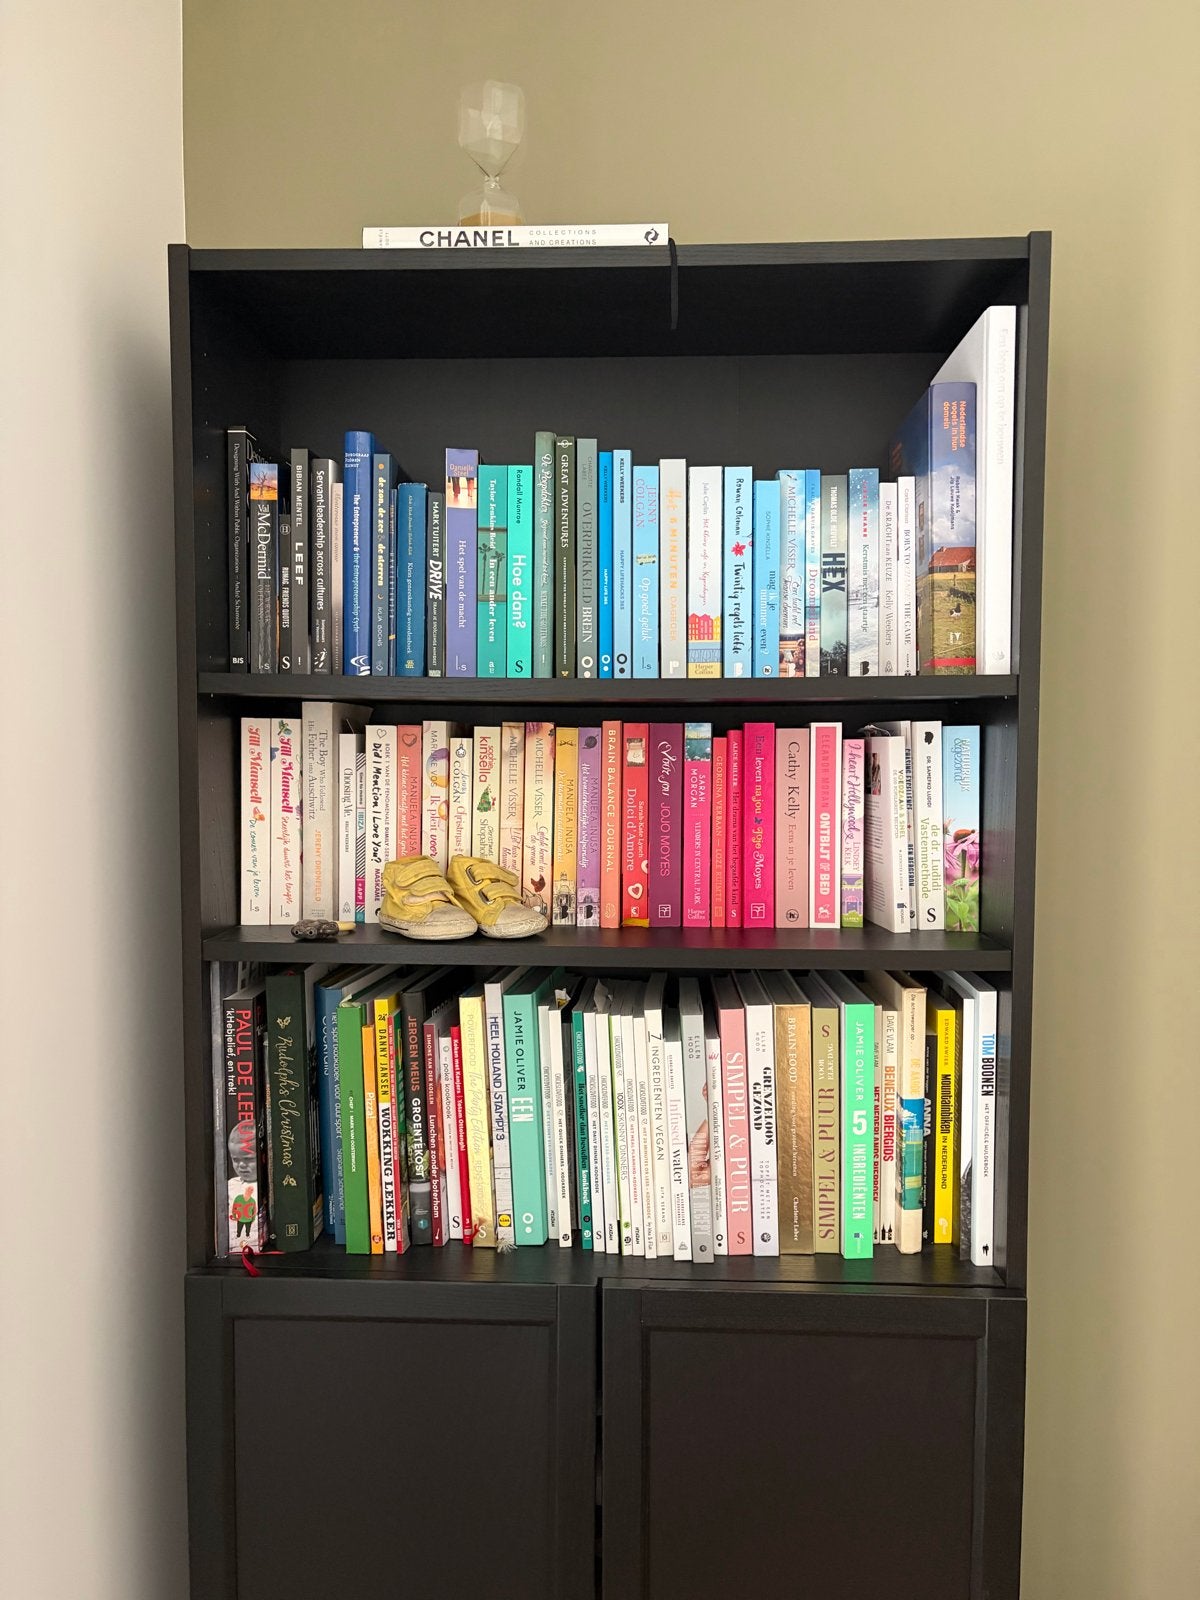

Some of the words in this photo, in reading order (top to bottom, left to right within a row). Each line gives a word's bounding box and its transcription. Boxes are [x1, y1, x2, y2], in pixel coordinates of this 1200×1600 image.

[420, 231, 520, 247] CHANEL
[315, 470, 325, 548] Servant-leadership
[560, 488, 568, 548] ADVENTURES
[636, 478, 644, 528] COLGAN
[648, 486, 656, 523] JENNY
[257, 512, 270, 579] McDermid
[582, 502, 592, 603] OVERPRIKKELD
[786, 538, 796, 572] VISSER
[429, 560, 442, 600] DRIVE
[457, 555, 466, 572] spel
[512, 554, 526, 586] Hoe
[729, 562, 744, 600] Twintig
[822, 552, 845, 592] HEX
[316, 578, 325, 610] cultures
[459, 592, 466, 602] de
[640, 578, 650, 592] Op
[884, 590, 894, 610] Kelly
[512, 591, 526, 628] dan?
[640, 594, 650, 614] goed
[731, 602, 744, 628] regels
[582, 606, 592, 642] BREIN
[642, 616, 650, 642] geluk
[732, 632, 744, 654] liefde
[248, 725, 260, 746] Jill
[280, 736, 292, 756] Jill
[308, 733, 317, 760] Father
[373, 743, 382, 759] Did
[755, 735, 764, 755] Een
[249, 748, 262, 803] Mansell
[318, 751, 328, 767] Boy
[479, 736, 492, 782] kinsella
[508, 736, 517, 784] MICHELLE
[535, 737, 544, 785] MICHELLE
[755, 757, 764, 782] leven
[785, 742, 800, 780] Cathy
[951, 738, 963, 783] &gezond
[960, 738, 970, 792] NATUURLIJK
[281, 759, 293, 813] Mansell
[308, 775, 317, 820] Auschwitz
[372, 766, 382, 808] Mention
[453, 760, 461, 803] COLGAN
[607, 767, 615, 817] BALANCE
[755, 785, 761, 796] na
[506, 788, 517, 819] VISSER
[533, 788, 544, 819] VISSER
[627, 788, 637, 819] Dolci
[660, 802, 670, 832] JOJO
[752, 796, 763, 814] jou
[785, 786, 800, 819] Kelly
[373, 816, 382, 838] Love
[752, 827, 763, 849] Jojo
[931, 825, 940, 837] de
[372, 842, 382, 863] You?
[606, 822, 614, 872] JOURNAL
[627, 822, 637, 871] d'Amore
[660, 836, 670, 876] MOYES
[920, 818, 930, 899] Vastenmethode
[931, 840, 940, 854] dr.
[754, 851, 764, 889] Moyes
[932, 859, 940, 891] Ludidi
[236, 1009, 252, 1055] PAUL
[408, 1016, 419, 1058] JEROEN
[490, 1017, 500, 1040] HEEL
[514, 1011, 524, 1045] JAMIE
[788, 1017, 797, 1049] BRAIN
[855, 1021, 864, 1056] JAMIE
[886, 1016, 895, 1033] DAVE
[379, 1029, 387, 1058] DANNY
[886, 1035, 895, 1054] VLAM
[982, 1034, 994, 1055] TOM
[237, 1061, 252, 1085] DE
[380, 1062, 389, 1095] JANSEN
[410, 1061, 420, 1091] MEUS
[492, 1043, 502, 1088] HOLLAND
[516, 1049, 526, 1091] OLIVER
[789, 1053, 798, 1082] FOOD
[856, 1060, 864, 1100] OLIVER
[981, 1058, 994, 1096] BOONEN
[366, 1092, 374, 1119] Pizza!
[726, 1052, 742, 1127] SIMPEL
[752, 1082, 762, 1130] GEZOND
[764, 1067, 774, 1145] GRENZELOOS
[884, 1066, 895, 1112] BENELUX
[940, 1074, 953, 1133] Mountainbiken
[237, 1092, 254, 1154] LEEUW
[494, 1092, 505, 1131] STAMPT
[511, 1097, 534, 1121] EEN
[670, 1099, 682, 1145] Infused
[852, 1110, 867, 1135] 5
[380, 1108, 392, 1177] WOKKING
[412, 1098, 425, 1177] GROENTEKOST
[429, 1115, 438, 1144] Lunchen
[729, 1134, 745, 1149] &
[883, 1115, 894, 1162] BIERGIDS
[430, 1147, 439, 1170] zonder
[673, 1149, 683, 1184] water
[432, 1173, 440, 1218] boterham
[731, 1157, 749, 1213] PUUR
[852, 1144, 868, 1219] INGREDIËNTEN
[384, 1181, 395, 1241] LEKKER
